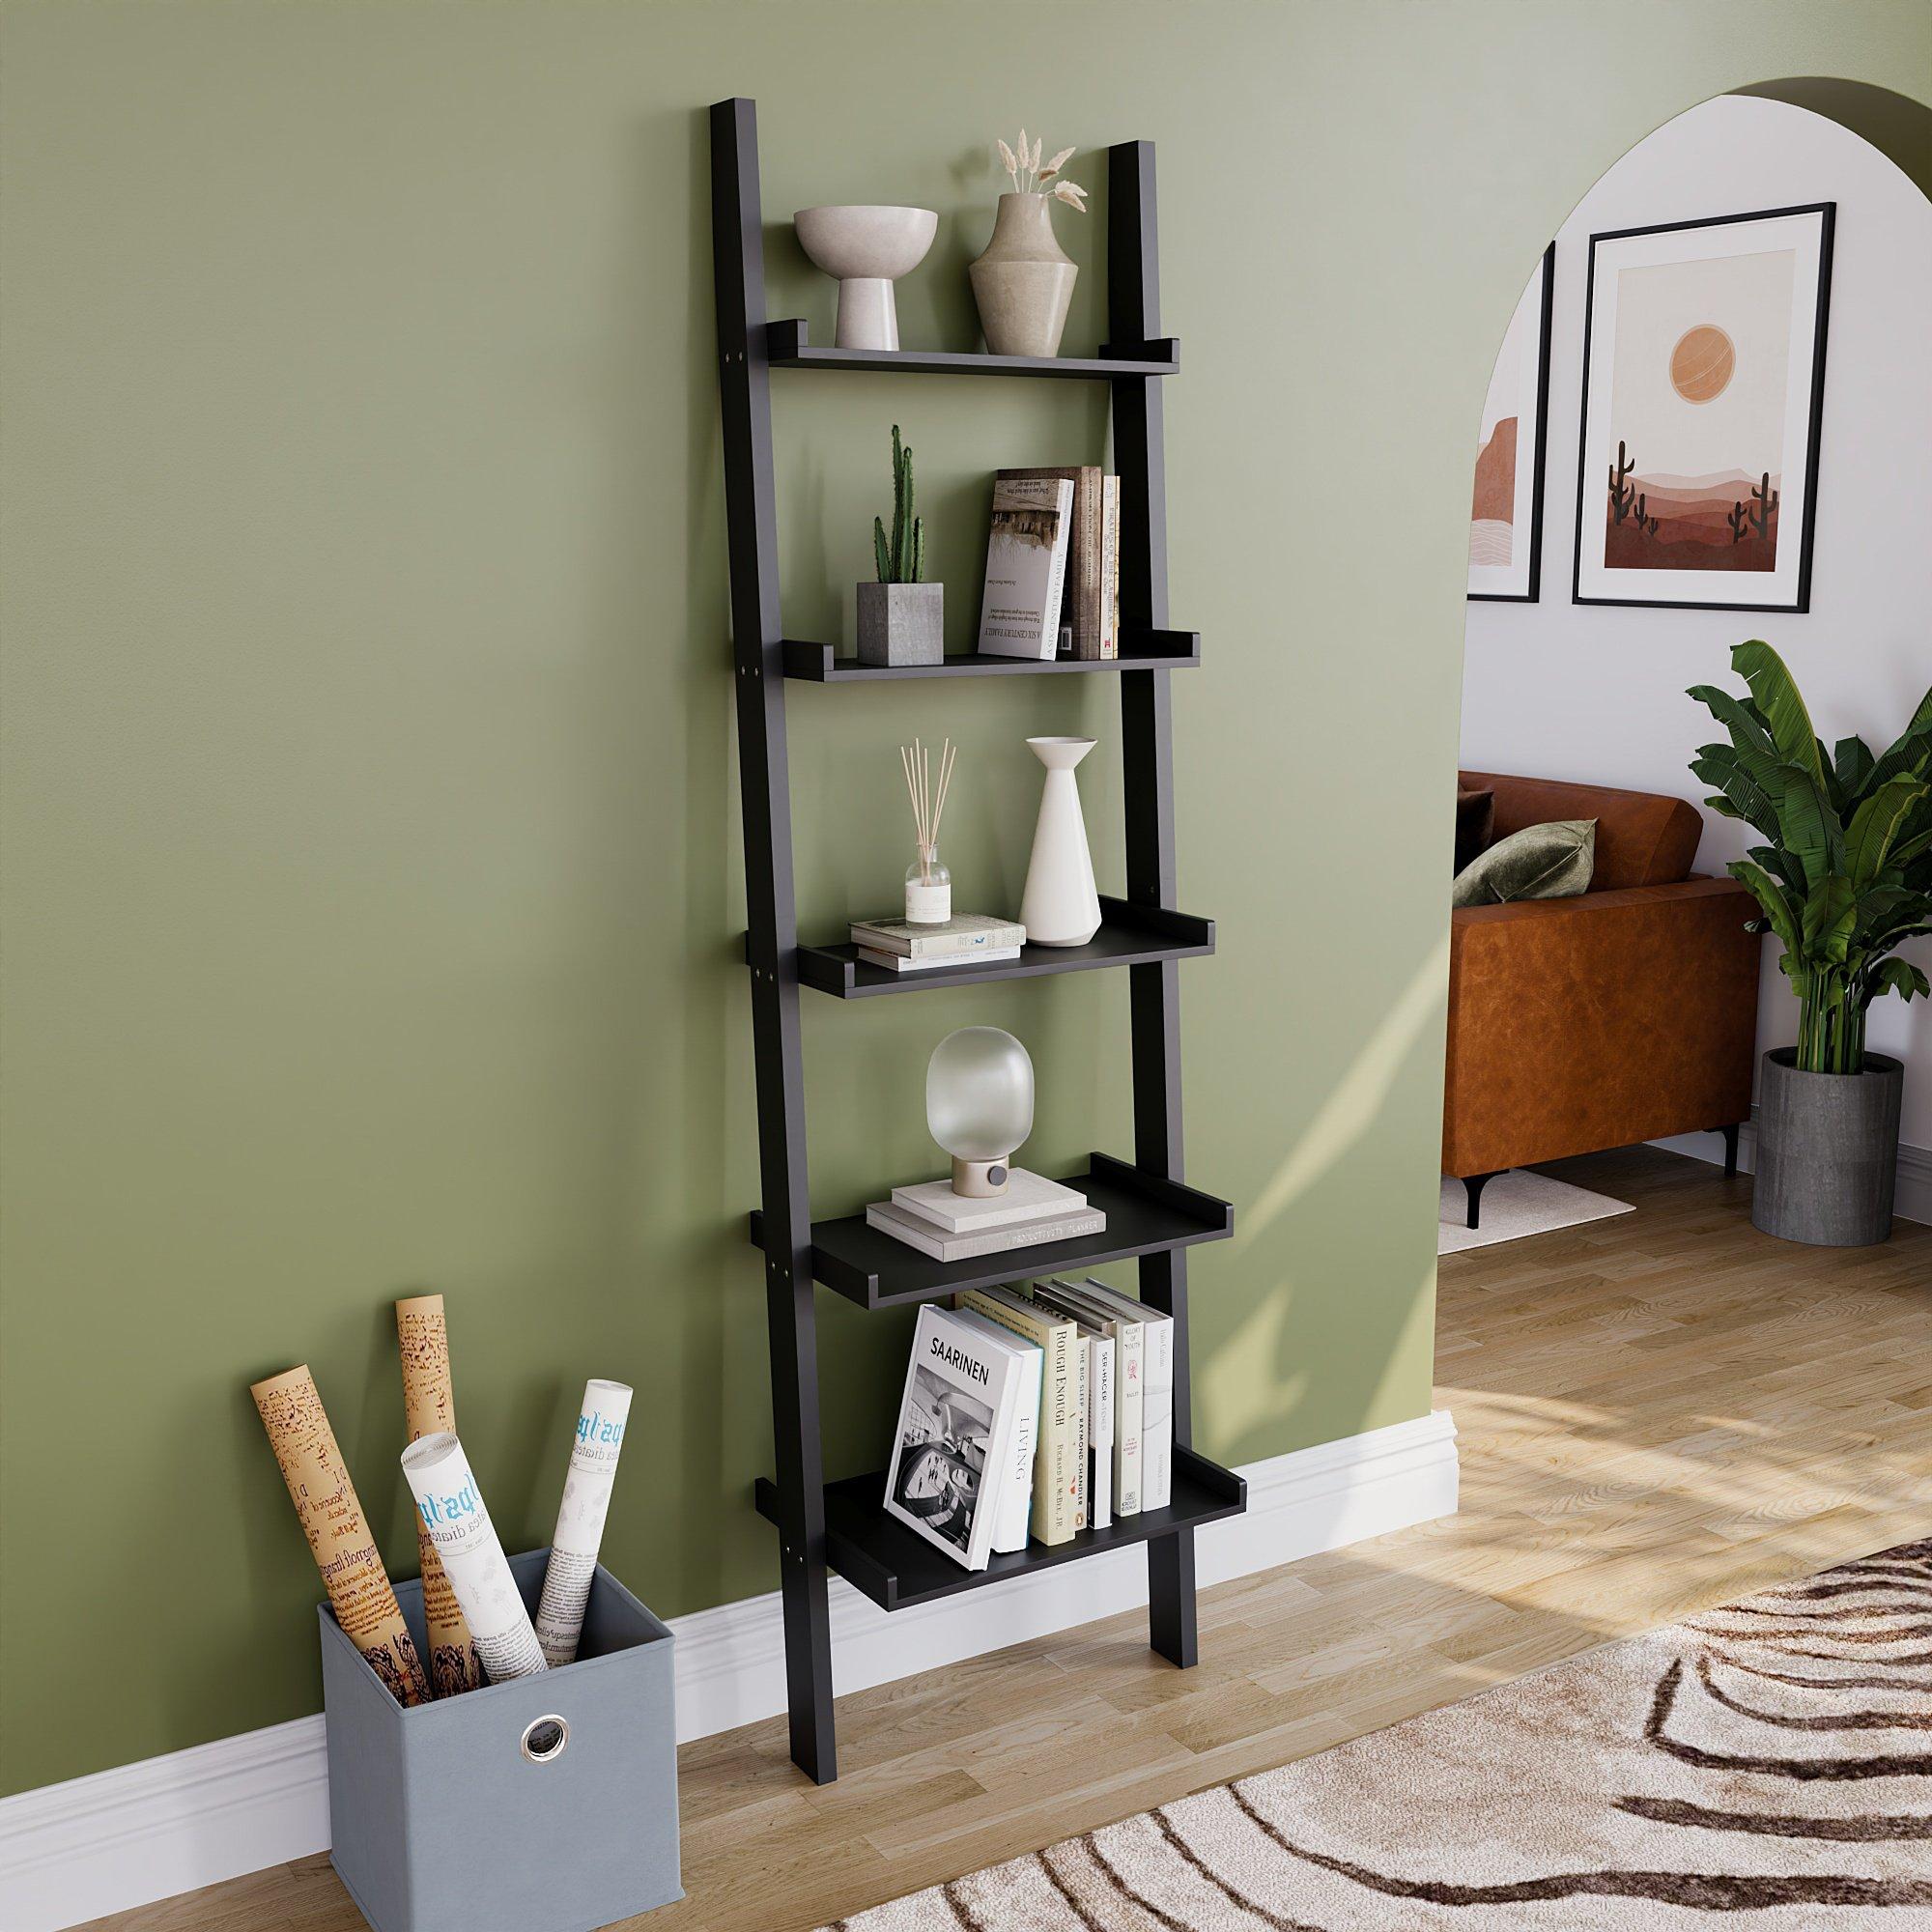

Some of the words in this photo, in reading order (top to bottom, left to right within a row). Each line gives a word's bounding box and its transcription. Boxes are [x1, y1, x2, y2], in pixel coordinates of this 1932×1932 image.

[1054, 551, 1064, 586] FAMILY
[1050, 587, 1061, 632] CENTURY
[984, 628, 1003, 637] FAMILY
[1004, 629, 1028, 639] CENTURY
[930, 1337, 989, 1386] SAARINEN
[1056, 1330, 1066, 1373] ROUGH
[1055, 1377, 1066, 1426] ENOUGH
[1015, 1417, 1030, 1480] LIVING
